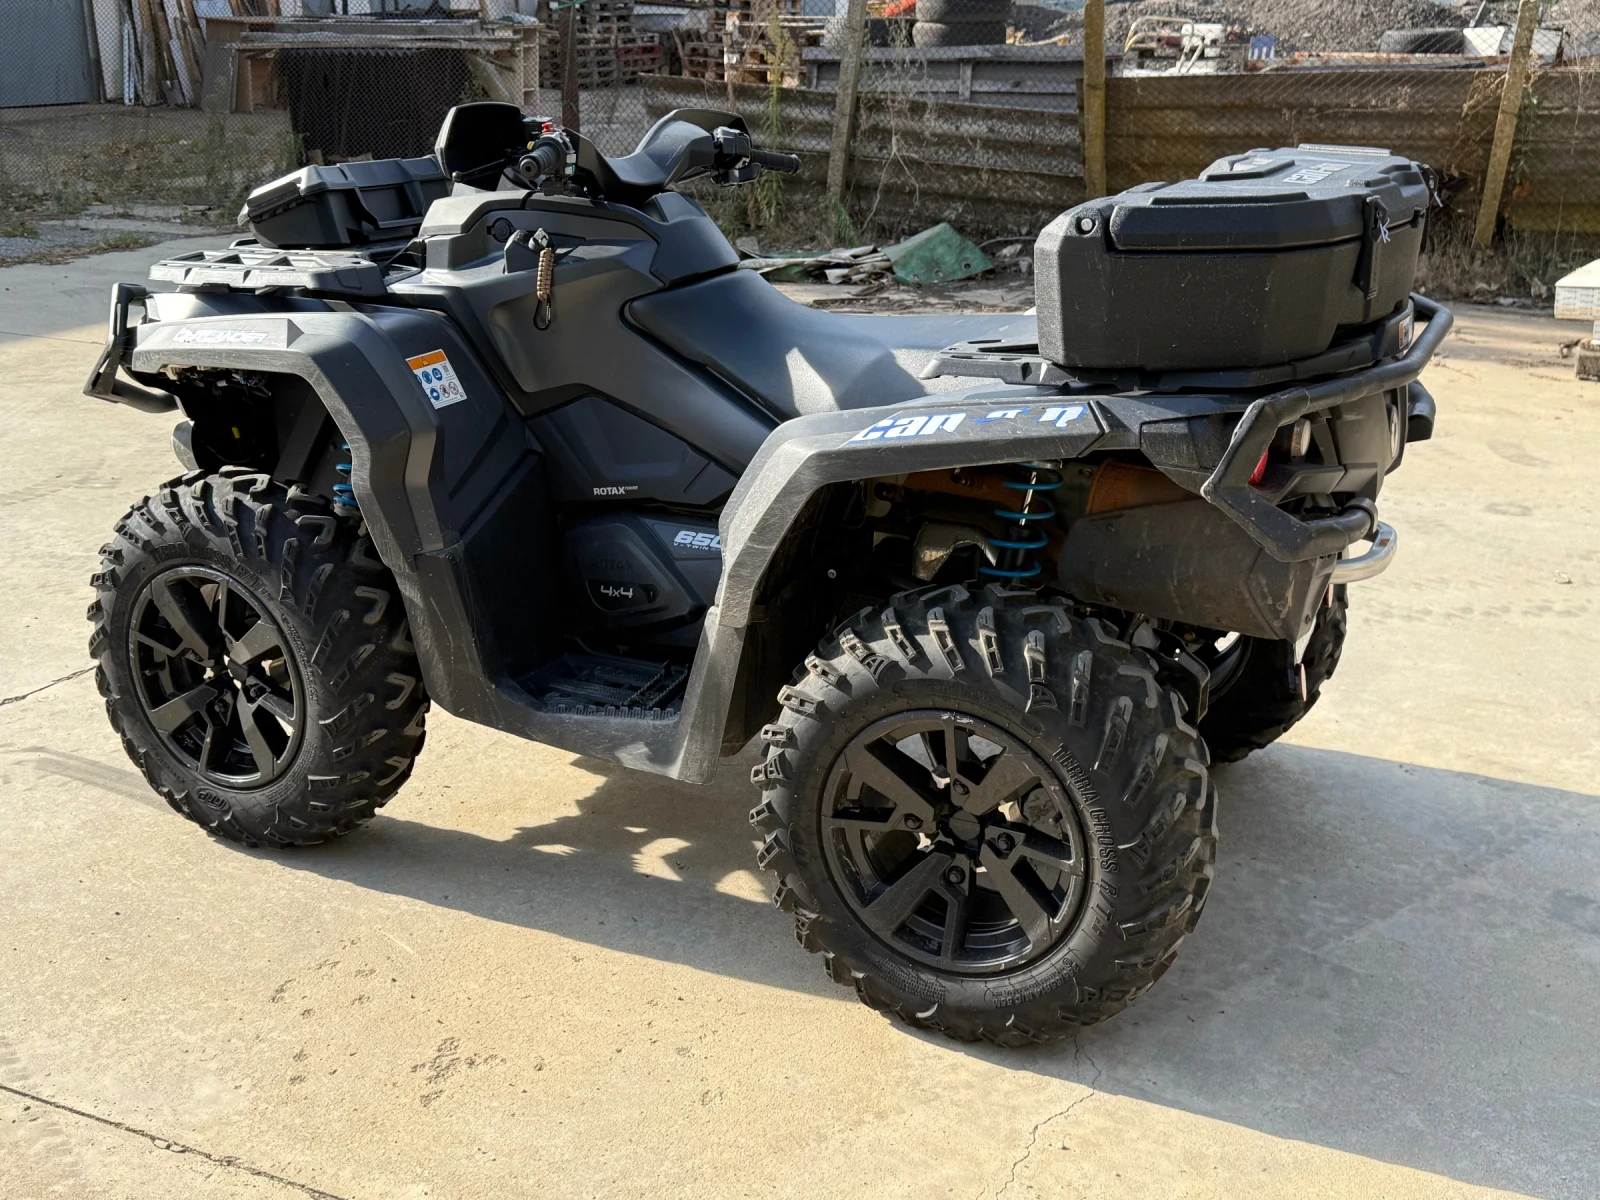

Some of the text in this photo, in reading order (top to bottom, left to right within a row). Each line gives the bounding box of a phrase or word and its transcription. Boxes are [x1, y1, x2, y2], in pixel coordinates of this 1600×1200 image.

[593, 486, 625, 496] ROTAX
[1052, 743, 1100, 805] TERRA
[1089, 807, 1119, 873] CROSS
